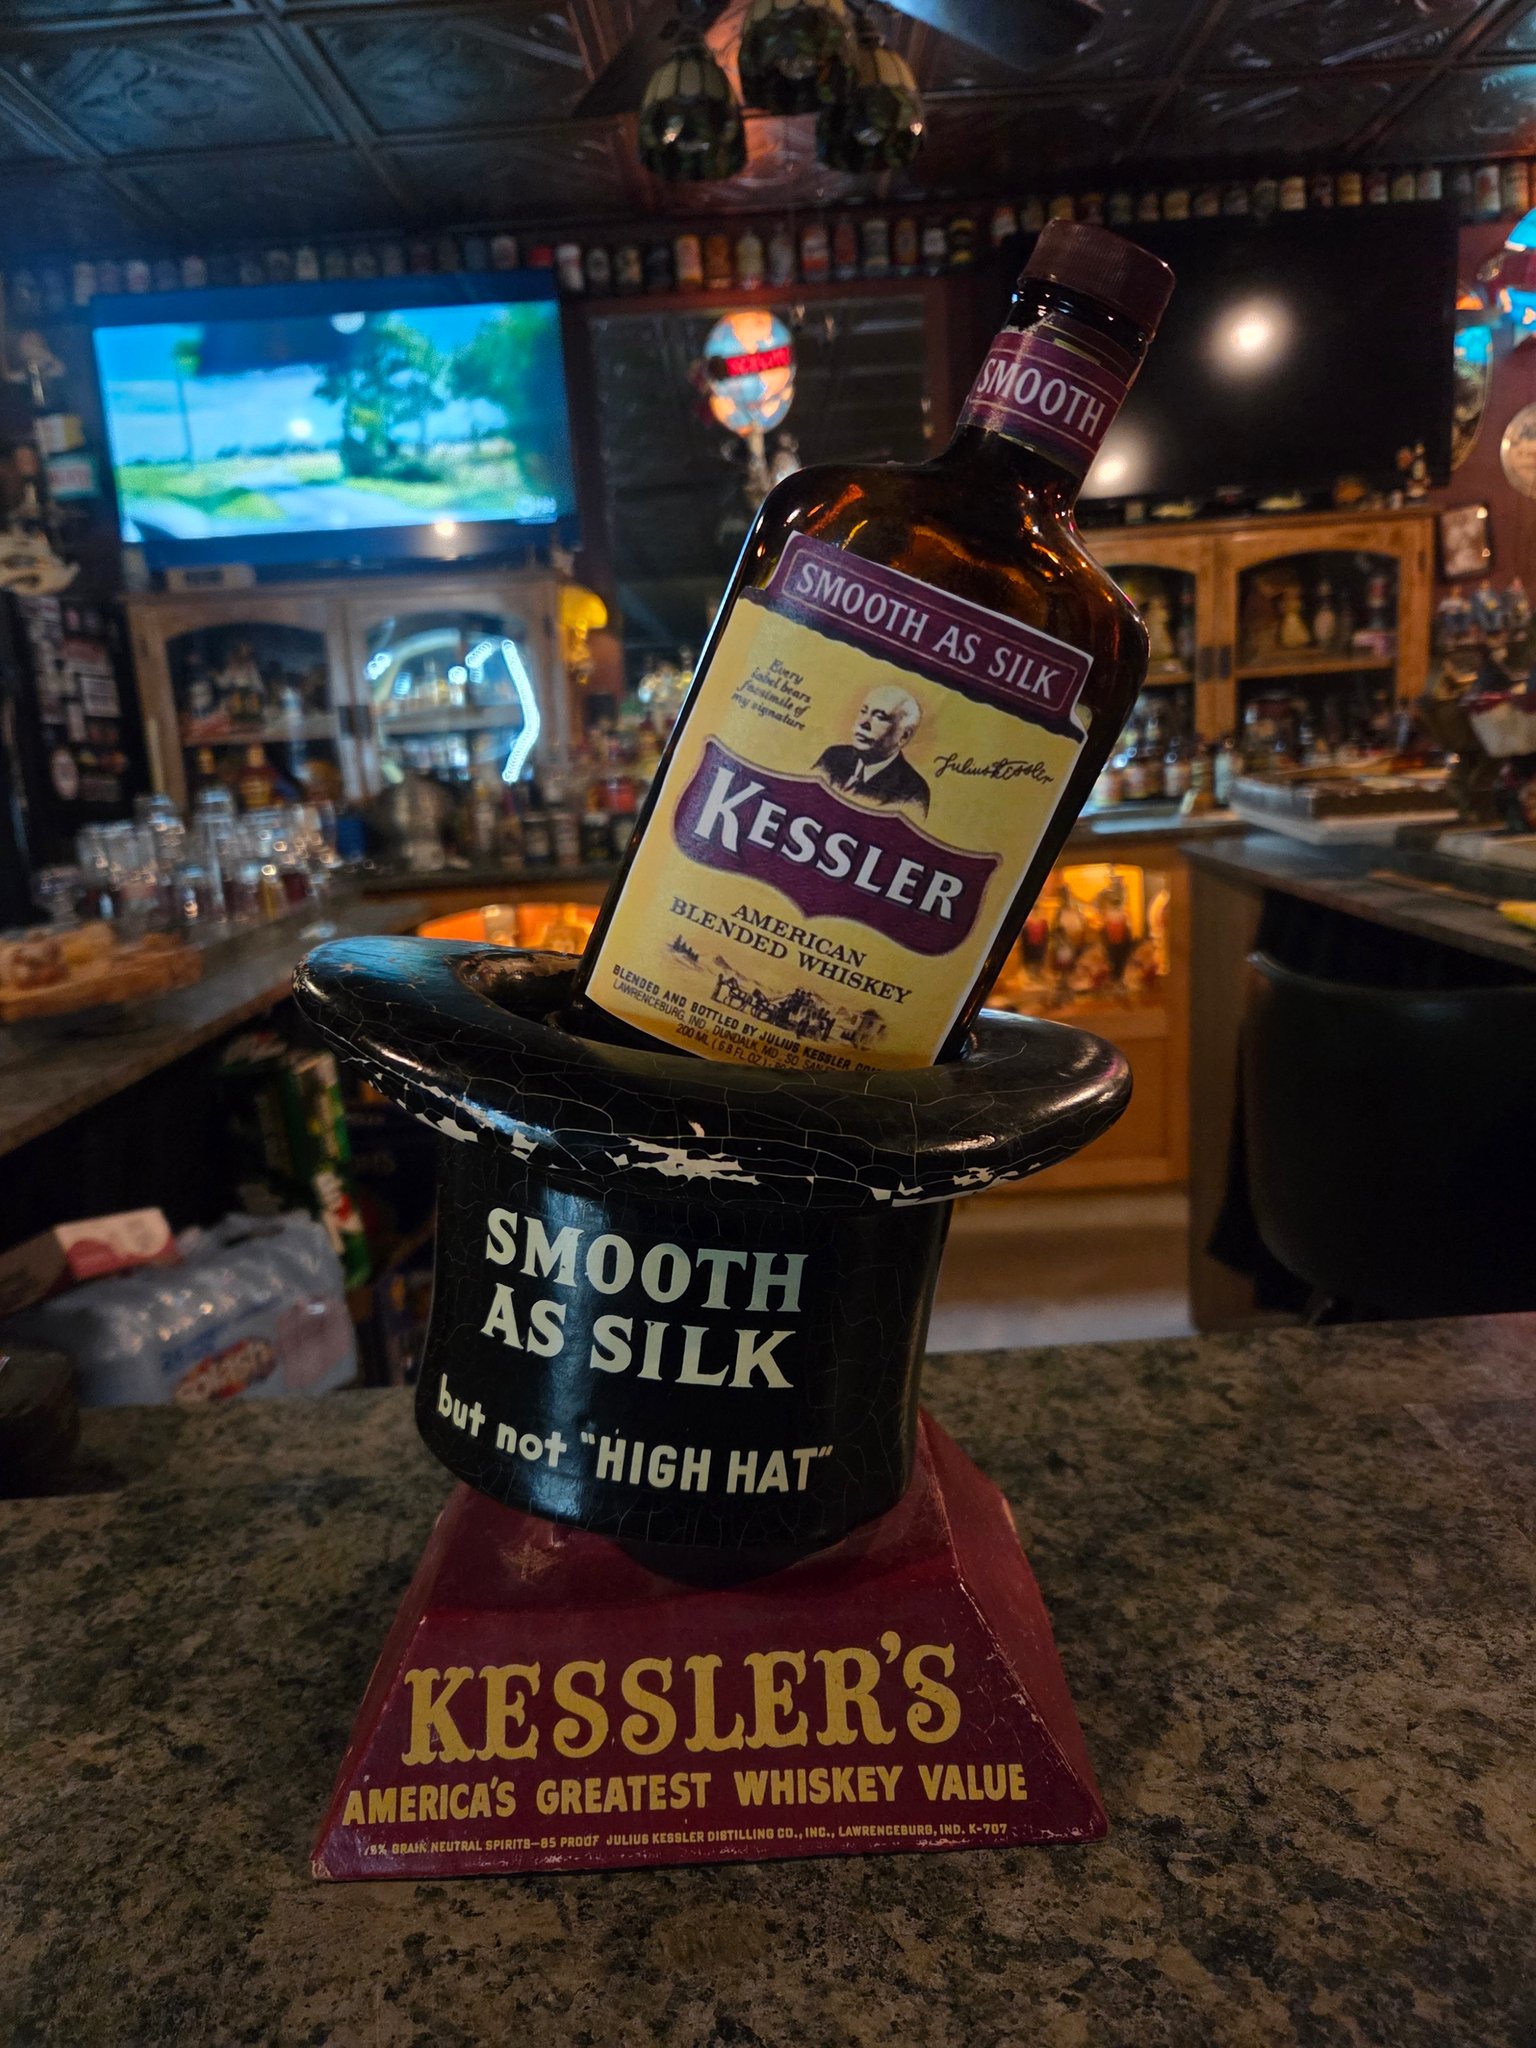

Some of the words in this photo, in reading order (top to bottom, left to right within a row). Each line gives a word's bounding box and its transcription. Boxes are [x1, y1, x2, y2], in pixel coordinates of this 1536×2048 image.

[977, 358, 1106, 438] SMOOTH
[769, 658, 804, 685] Every
[796, 563, 930, 643] SMOOTH
[933, 626, 982, 665] AS
[988, 647, 1061, 700] SILK
[731, 692, 751, 709] my
[751, 702, 806, 731] signature
[736, 680, 794, 710] facsimile
[794, 705, 812, 718] of
[780, 680, 812, 703] bears
[693, 767, 965, 921] KESSLER
[669, 896, 789, 959] BLENDED
[797, 951, 913, 1004] WHISKEY
[731, 904, 868, 968] AMERICAN
[613, 964, 660, 995] BLENDED
[663, 990, 687, 1007] AND
[690, 1002, 740, 1029] BOTTLED
[742, 1023, 758, 1037] BY
[759, 1031, 801, 1054] JULIUS
[802, 1046, 852, 1070] KESSLER
[676, 1023, 695, 1038] 200
[485, 1207, 809, 1313] SMOOTH
[480, 1283, 567, 1358] AS
[589, 1315, 797, 1389] SILK
[437, 1373, 486, 1438] but
[496, 1421, 568, 1468] not
[401, 1630, 962, 1767] KESSLER'S
[342, 1776, 517, 1826] AMERICA'S
[536, 1772, 711, 1816] GREATEST
[734, 1766, 903, 1807] WHISKEY
[918, 1763, 1028, 1801] VALUE
[391, 1841, 428, 1855] GRAIN
[430, 1839, 483, 1854] NEUTRAL
[560, 1834, 600, 1848] PROOF
[606, 1833, 649, 1846] JULIUS
[652, 1831, 704, 1845] KESSLER
[707, 1828, 774, 1842] DISTILLING
[838, 1824, 938, 1838] LAWRENCEBURG,
[940, 1823, 966, 1836] IND.
[969, 1823, 1008, 1836] K-707
